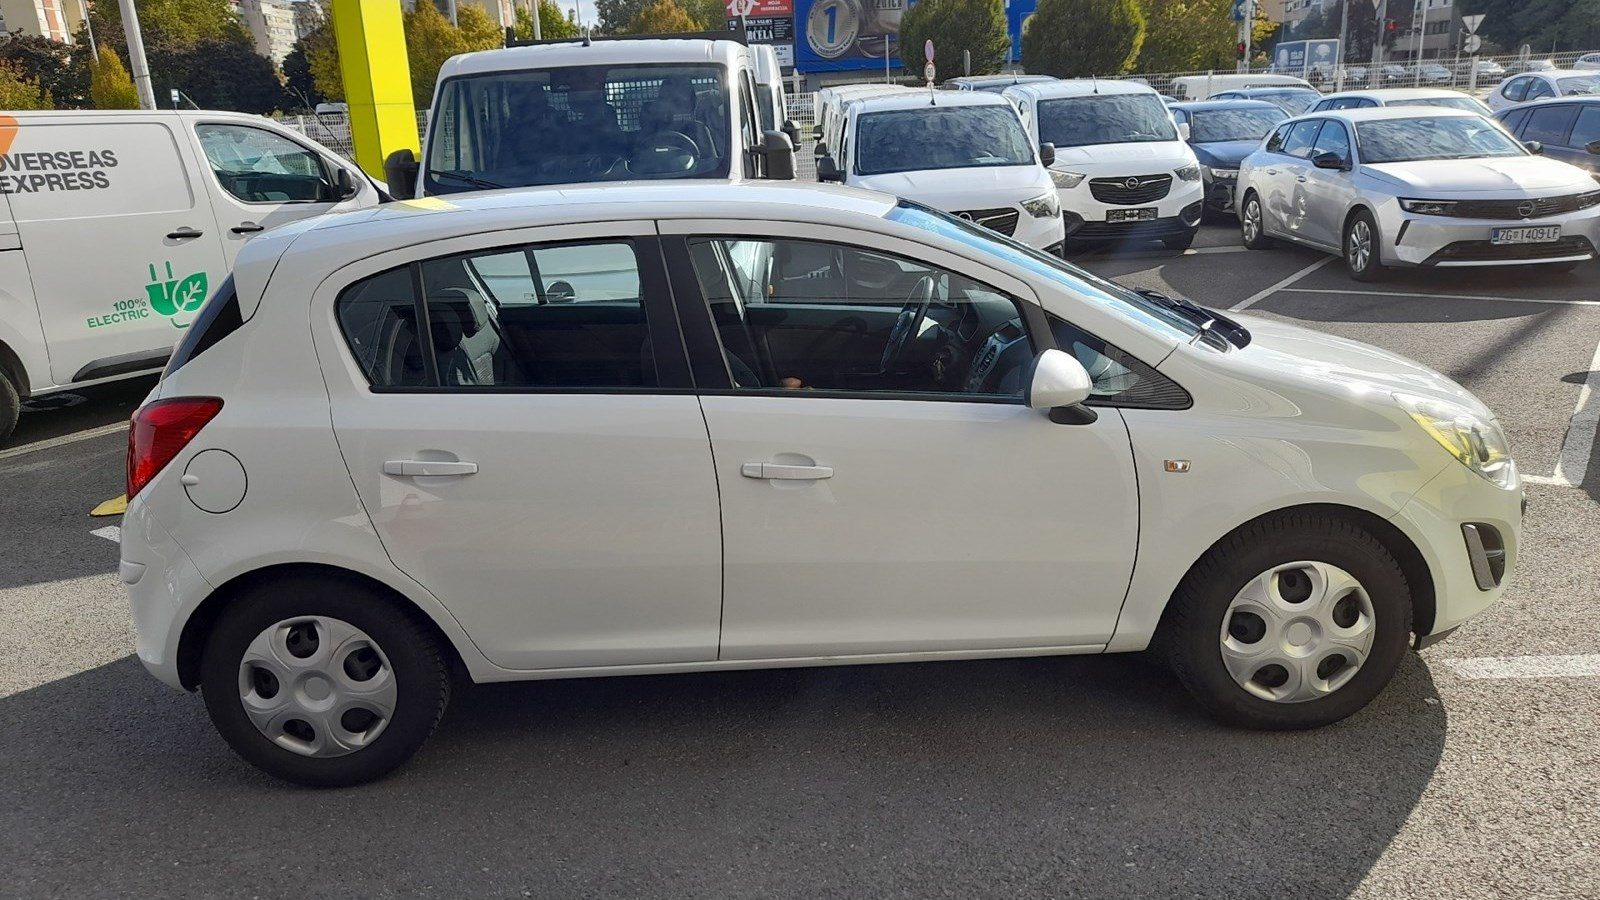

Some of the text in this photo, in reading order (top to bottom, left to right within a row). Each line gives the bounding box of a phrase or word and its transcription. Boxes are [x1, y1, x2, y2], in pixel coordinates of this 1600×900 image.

[824, 6, 837, 43] 1
[0, 171, 110, 194] EXPRESS
[1500, 230, 1512, 240] ZG
[113, 298, 146, 311] 100%
[87, 308, 149, 328] ELECTRIC
